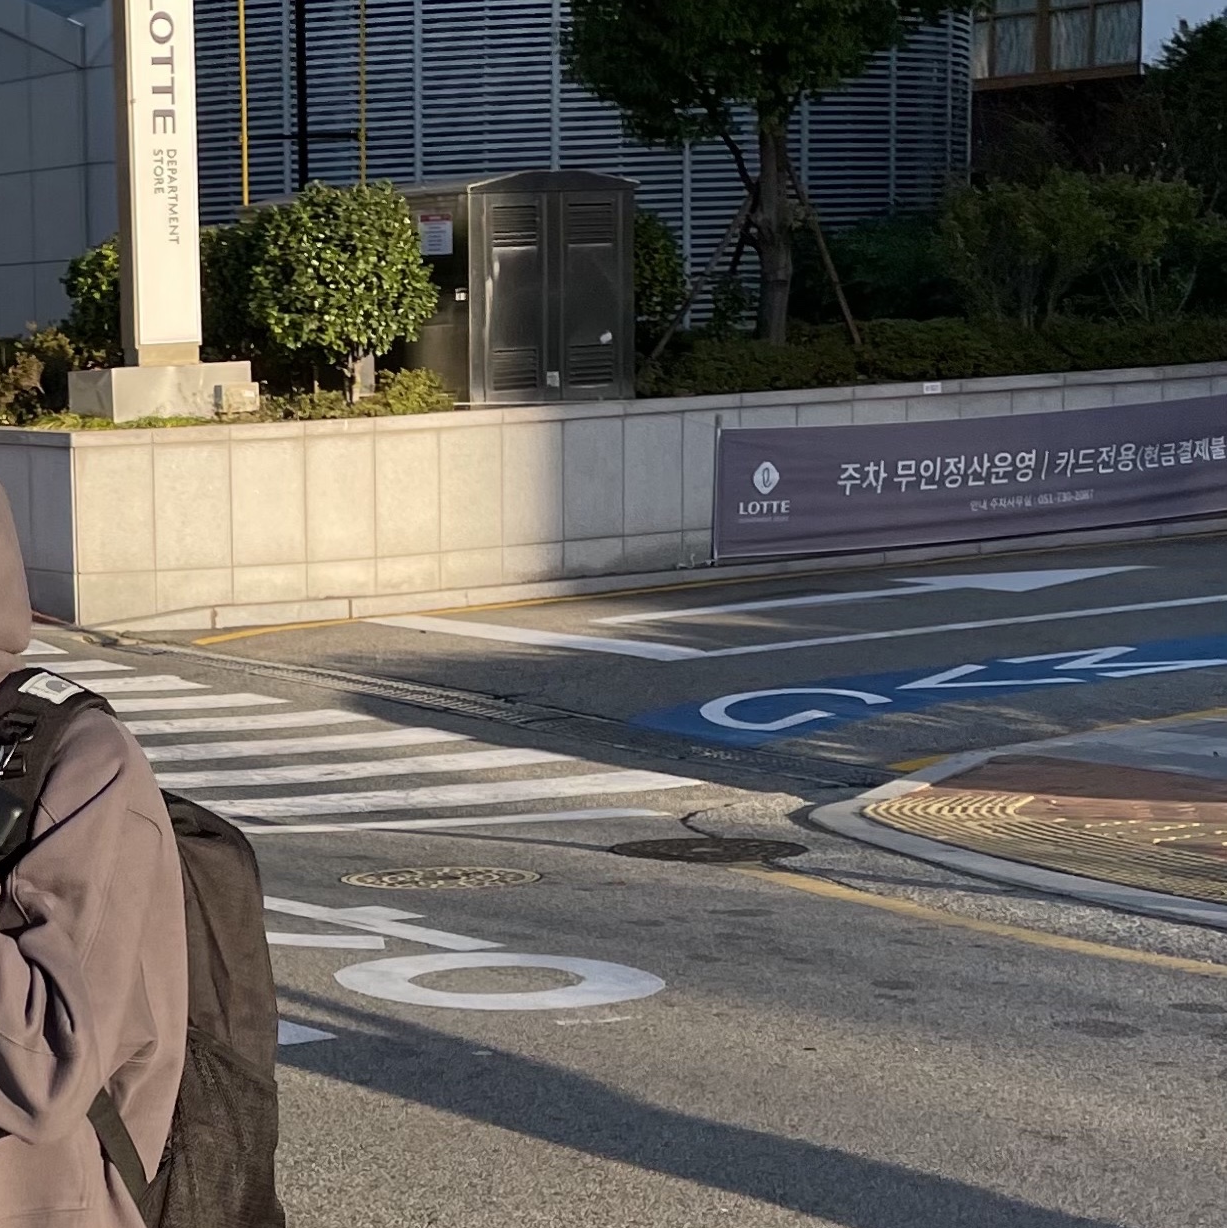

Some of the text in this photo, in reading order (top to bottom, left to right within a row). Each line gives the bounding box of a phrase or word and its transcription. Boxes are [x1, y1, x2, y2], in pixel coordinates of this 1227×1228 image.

[153, 149, 165, 195] STORE
[166, 149, 180, 245] DEPARTMENT
[837, 460, 888, 496] 주차
[893, 449, 1037, 492] 무인정산운영
[738, 500, 791, 515] LOTTE
